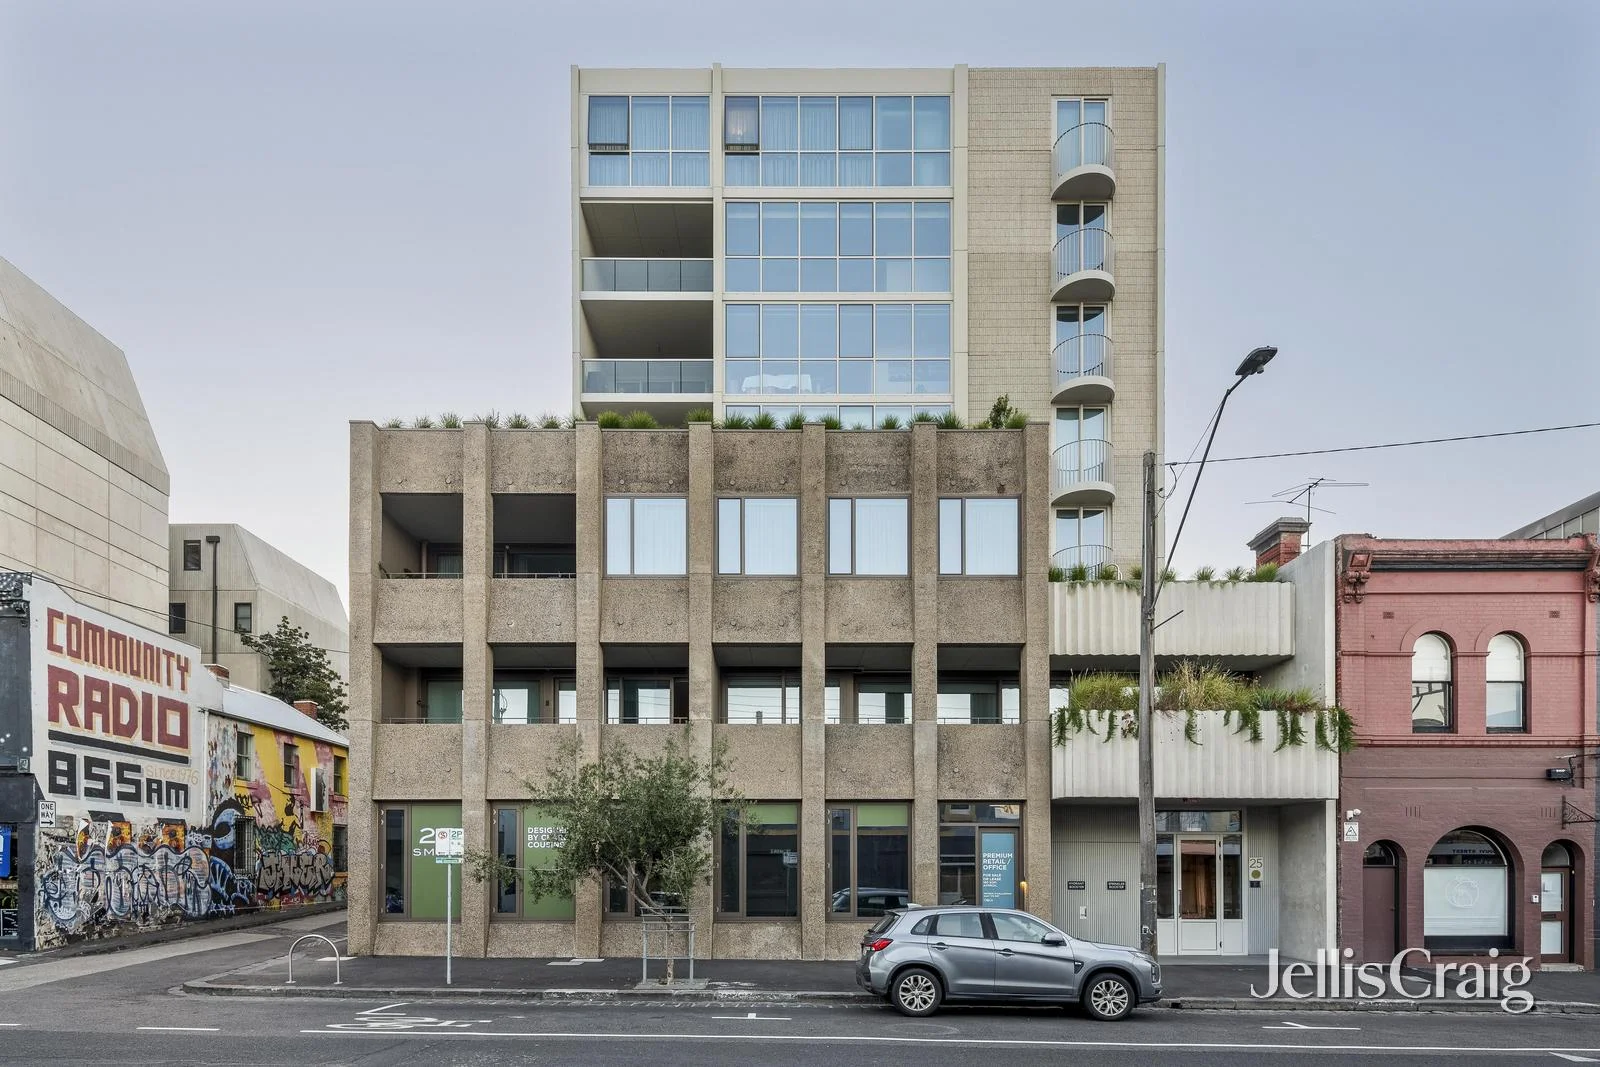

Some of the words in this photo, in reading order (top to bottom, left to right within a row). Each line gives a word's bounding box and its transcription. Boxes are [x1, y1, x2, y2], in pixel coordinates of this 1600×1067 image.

[47, 607, 190, 692] COMMUNITY
[47, 664, 190, 750] RADIO
[419, 827, 436, 844] 2
[527, 841, 565, 849] COUSINS
[1249, 858, 1263, 869] 25
